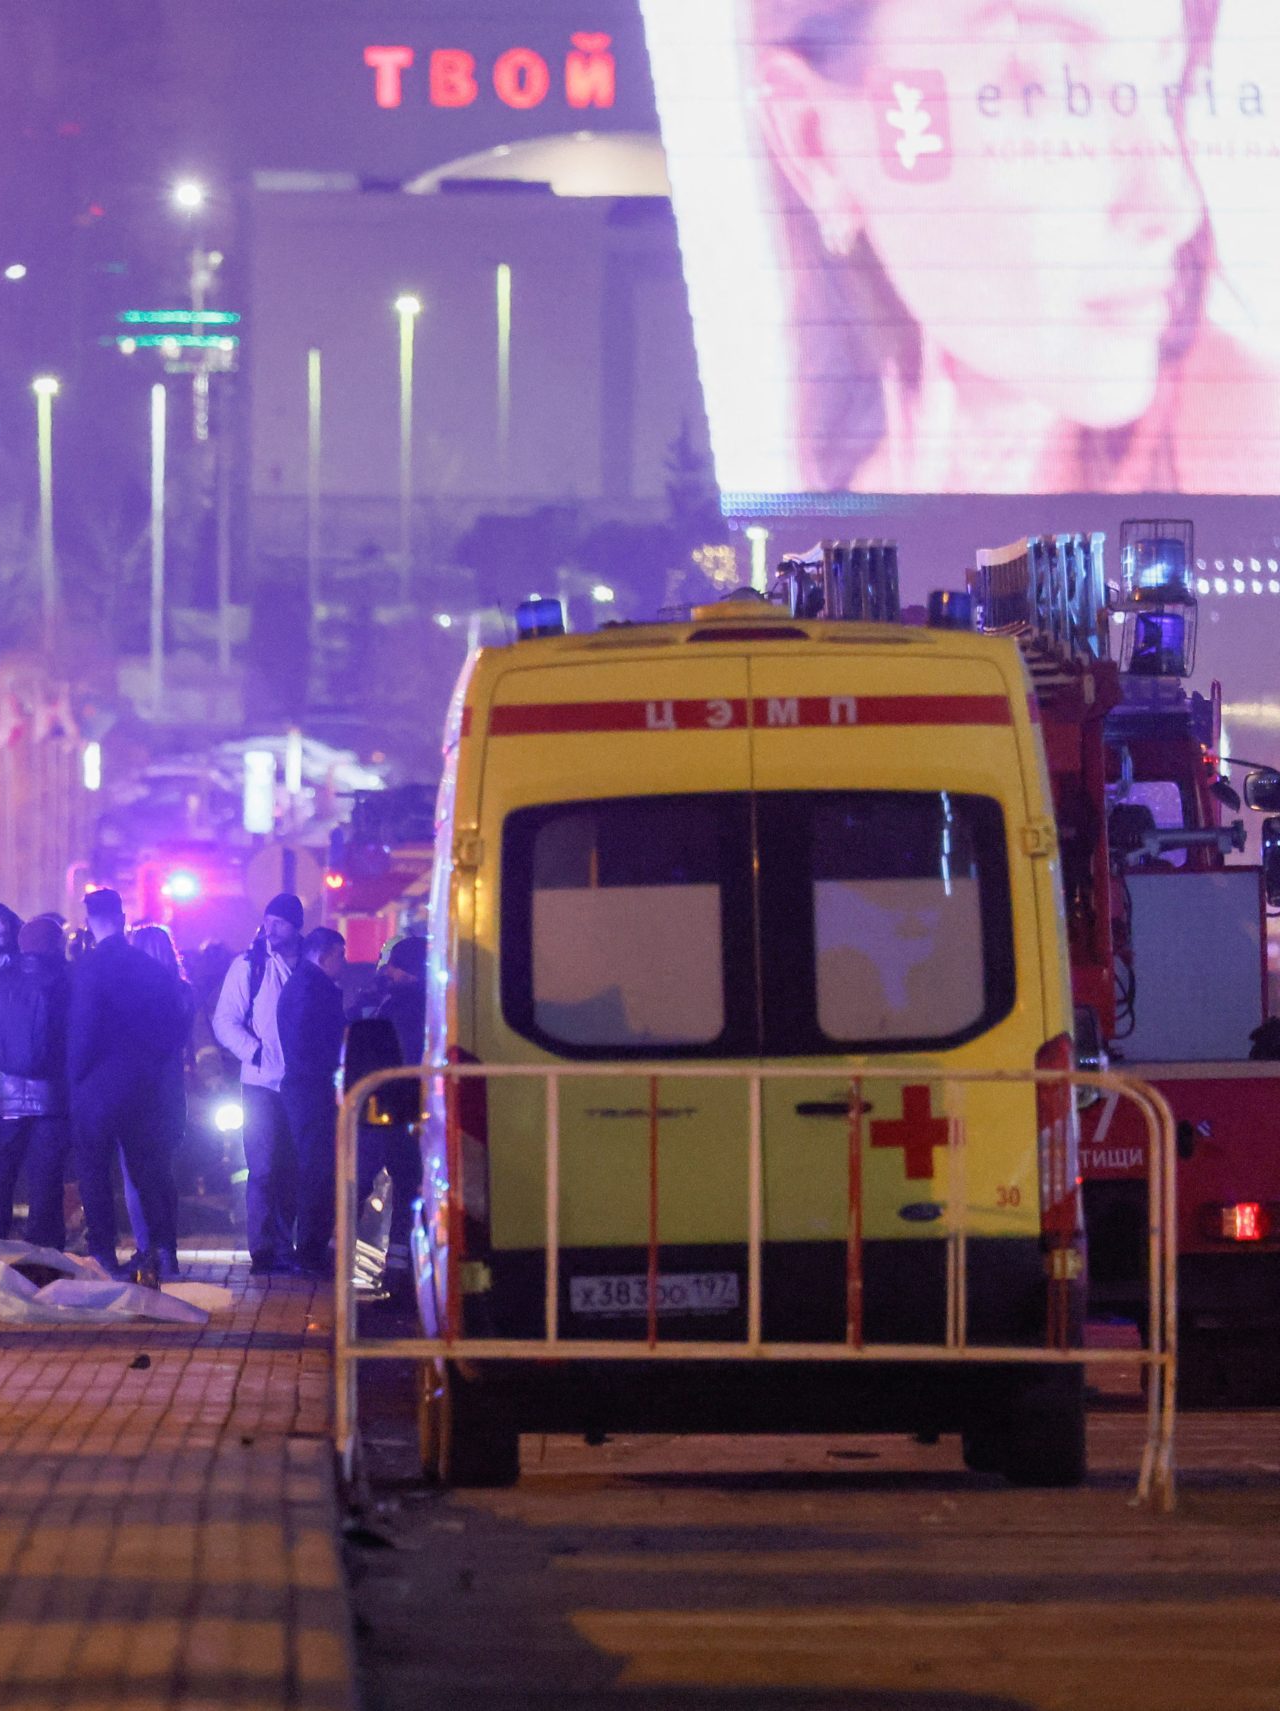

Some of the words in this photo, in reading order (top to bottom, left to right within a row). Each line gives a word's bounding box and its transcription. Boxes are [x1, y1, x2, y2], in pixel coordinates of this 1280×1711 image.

[364, 31, 616, 109] ТВОЙ
[1079, 1148, 1144, 1169] ТИЩИ
[995, 1185, 1022, 1208] 30
